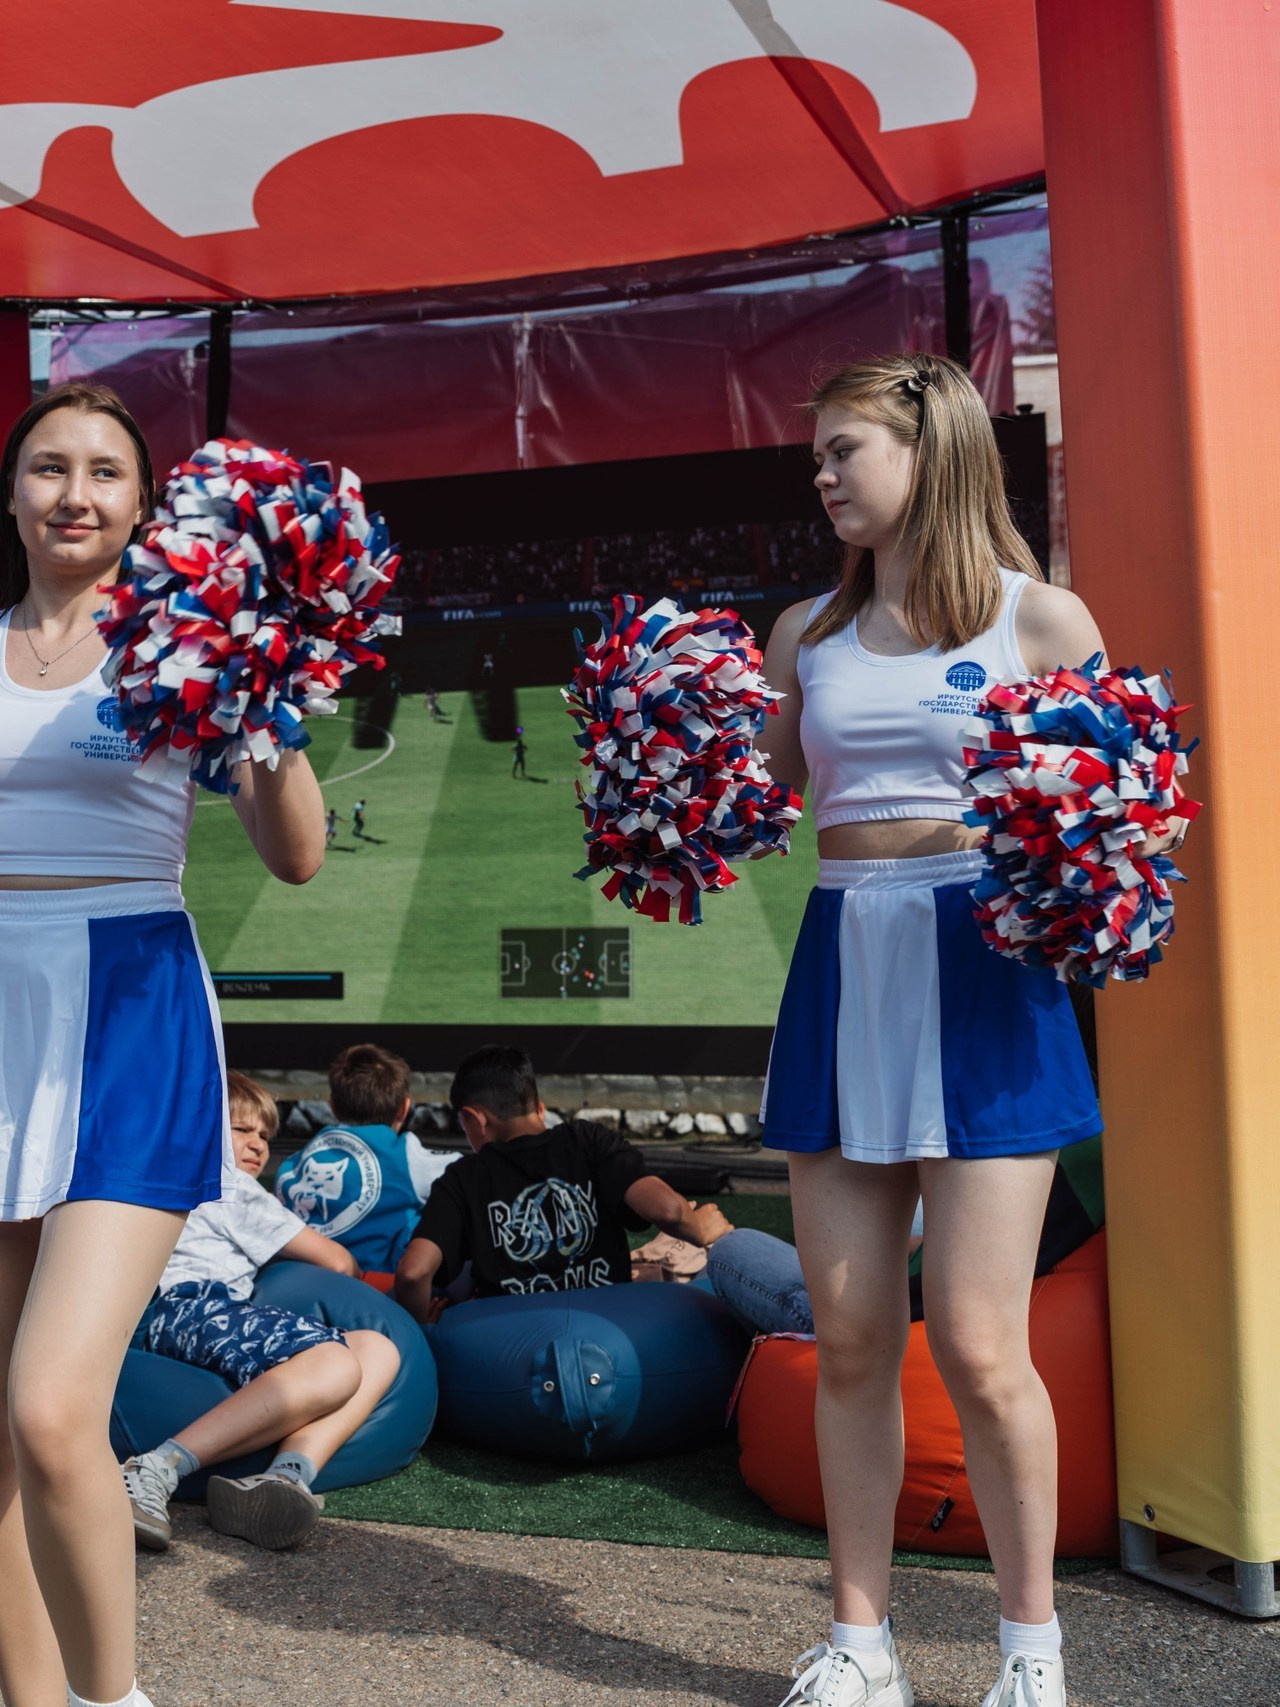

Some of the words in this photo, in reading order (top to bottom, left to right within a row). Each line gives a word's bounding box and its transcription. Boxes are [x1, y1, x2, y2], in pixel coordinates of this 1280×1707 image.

[937, 693, 981, 703] ИРКУТСК
[931, 707, 972, 716] УНИВЕРС
[90, 734, 129, 745] ИРКУТС
[70, 741, 140, 754] ГОСУДАРСТВЕН
